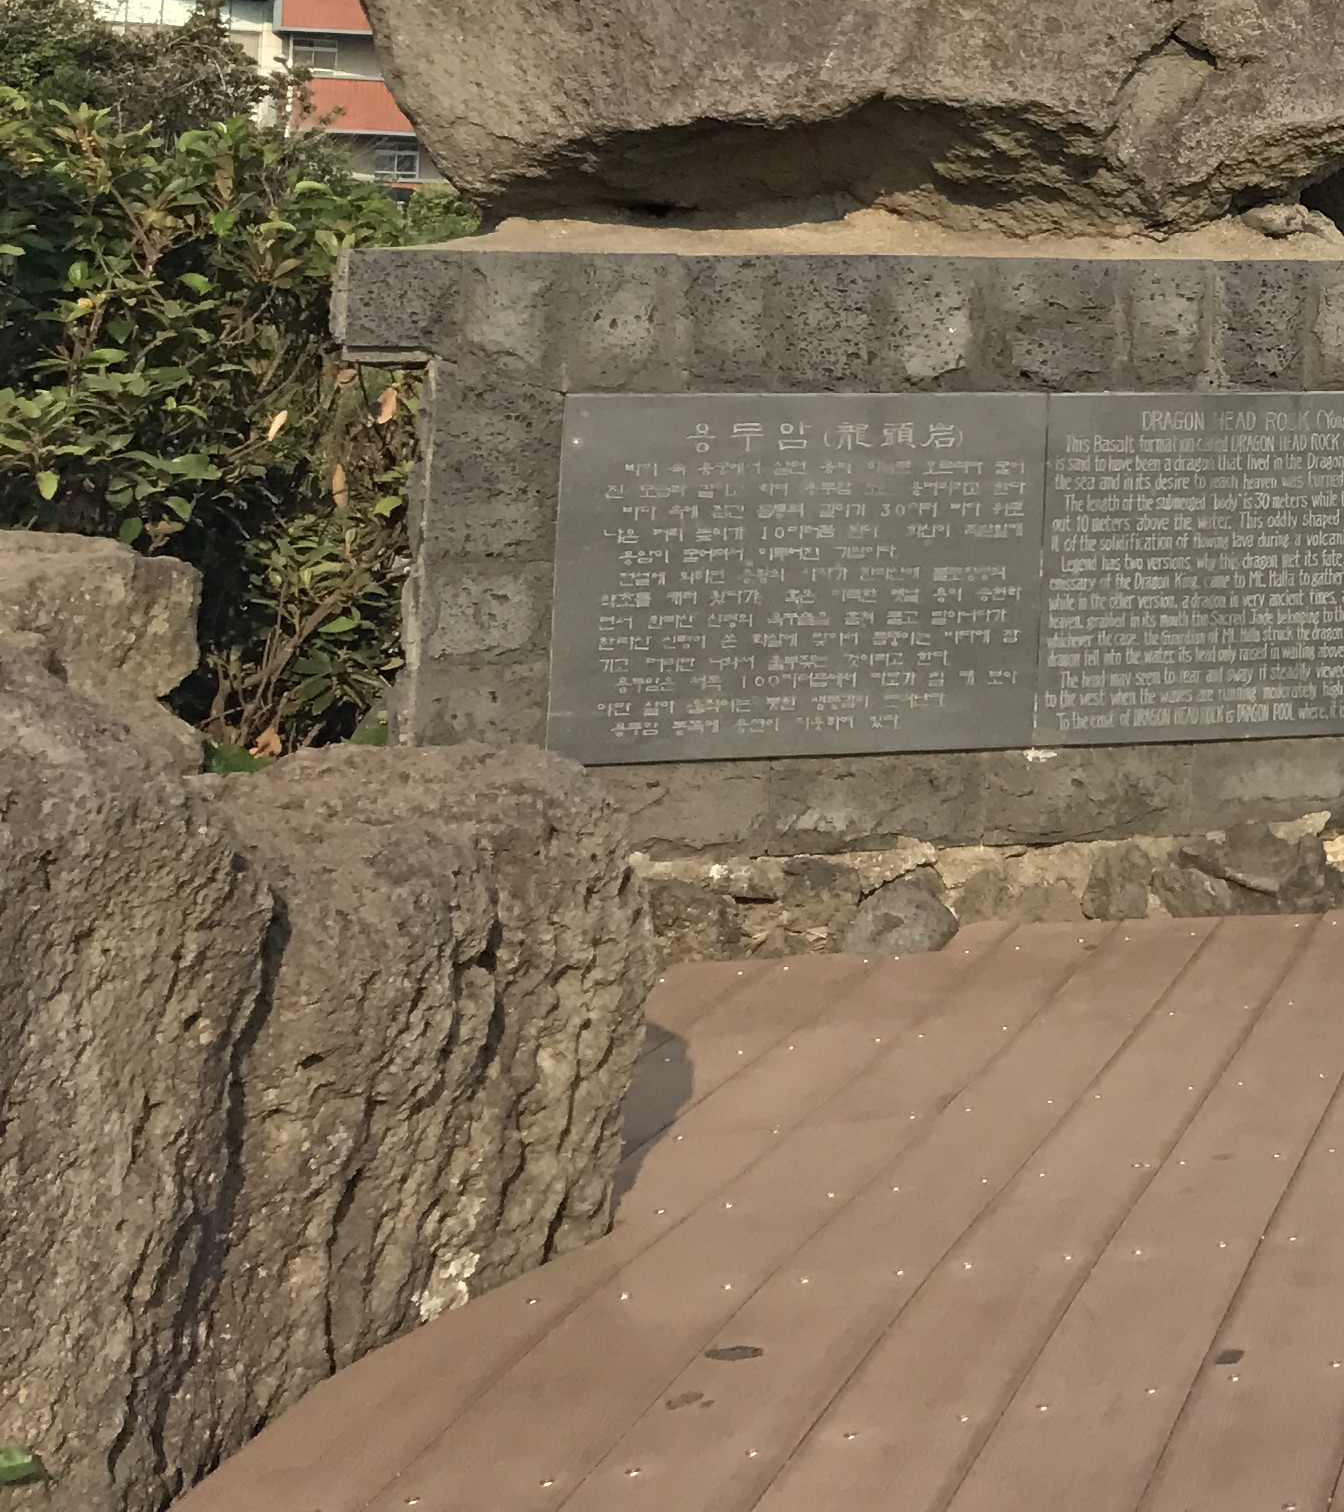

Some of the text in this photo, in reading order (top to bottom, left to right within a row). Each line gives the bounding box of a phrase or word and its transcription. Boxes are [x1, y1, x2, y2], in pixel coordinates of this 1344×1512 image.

[1142, 411, 1205, 431] DRAGON
[1066, 434, 1090, 454] This
[1311, 433, 1340, 451] ROCK
[1055, 455, 1065, 471] is
[1094, 455, 1106, 471] to
[1108, 455, 1132, 471] have
[1135, 454, 1161, 471] been
[1164, 458, 1172, 471] a
[1173, 454, 1216, 473] dragon
[1218, 454, 1242, 471] that
[1247, 452, 1270, 470] lived
[1273, 454, 1283, 470] in
[1285, 453, 1303, 469] the
[1307, 452, 1344, 470] Dragon
[1054, 474, 1073, 490] the
[1074, 476, 1096, 489] sea
[1099, 474, 1120, 490] and
[1154, 472, 1190, 490] desire
[1193, 473, 1206, 489] to
[1308, 470, 1344, 488] turned
[1064, 494, 1083, 512] The
[1122, 494, 1134, 511] of
[1137, 493, 1154, 510] the
[1254, 491, 1270, 510] 30
[1272, 492, 1308, 509] meters
[1311, 490, 1337, 508] while
[1052, 515, 1071, 532] out
[1076, 514, 1090, 533] 10
[1091, 514, 1131, 532] meters
[1136, 513, 1169, 532] above
[1173, 513, 1193, 531] the
[1238, 510, 1264, 530] This
[1267, 509, 1298, 529] oddly
[1301, 509, 1340, 529] shaped
[1063, 534, 1078, 552] of
[1079, 534, 1096, 552] the
[1175, 533, 1189, 550] of
[1231, 531, 1254, 549] lava
[1101, 554, 1122, 572] has
[1124, 552, 1143, 571] two
[1242, 551, 1278, 570] dragon
[1115, 573, 1132, 590] the
[1134, 572, 1170, 590] Dragon
[1233, 571, 1246, 589] to
[1269, 569, 1296, 587] Halla
[1299, 568, 1310, 586] to
[1268, 589, 1305, 606] ancient
[1211, 608, 1246, 627] Sacred
[1311, 624, 1344, 642] dragon
[599, 658, 629, 673] 기고
[1061, 670, 1079, 689] The
[1163, 666, 1175, 685] to
[1044, 690, 1058, 709] to
[610, 721, 660, 737] 용두암
[1056, 711, 1071, 731] To
